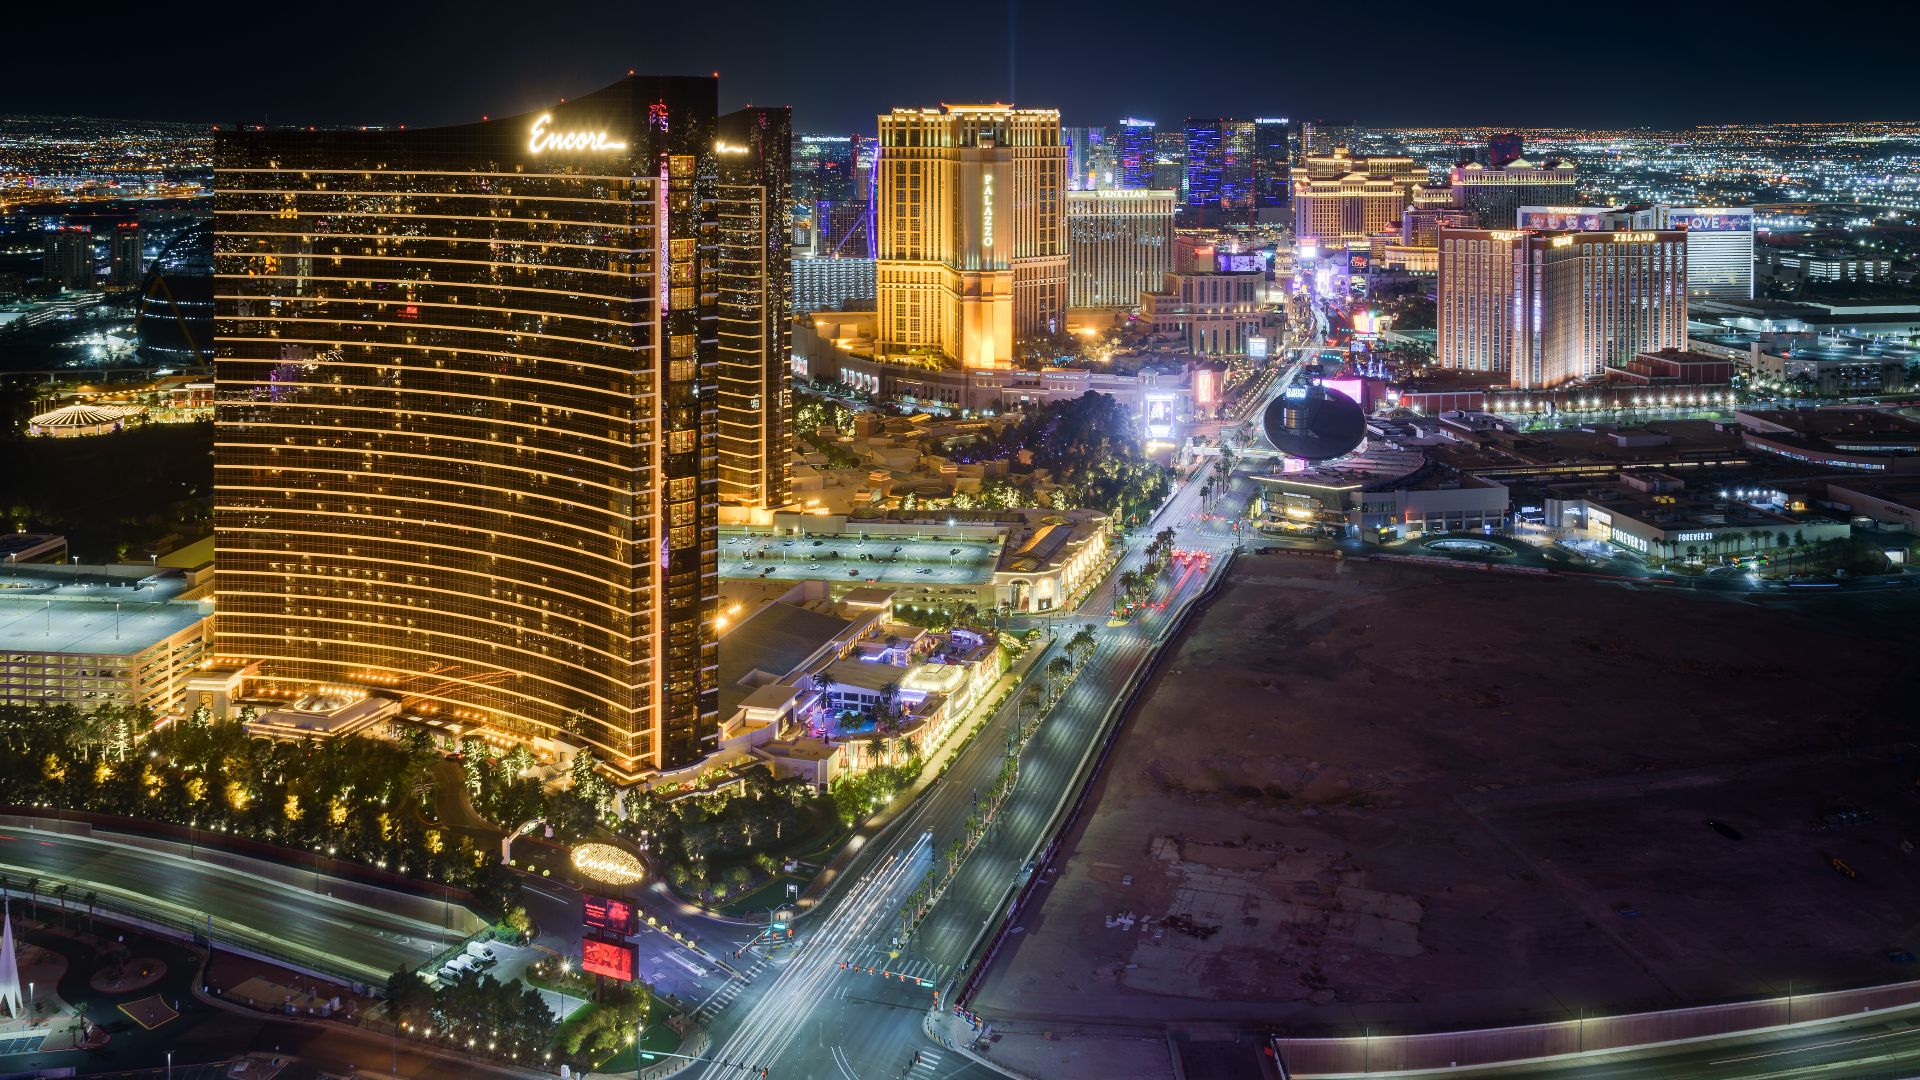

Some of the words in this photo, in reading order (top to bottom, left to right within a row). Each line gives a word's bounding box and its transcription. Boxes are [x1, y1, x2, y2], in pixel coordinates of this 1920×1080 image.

[528, 114, 627, 154] Encore
[1098, 189, 1148, 198] VENETIAN
[984, 175, 993, 247] PALAZZO
[1685, 217, 1720, 229] LOVE
[1614, 233, 1656, 242] ISLAND
[1612, 528, 1639, 549] FOREVER
[1639, 541, 1648, 552] 21
[1678, 533, 1705, 542] FOREVER
[1705, 532, 1713, 540] 21
[576, 849, 642, 878] Encore
